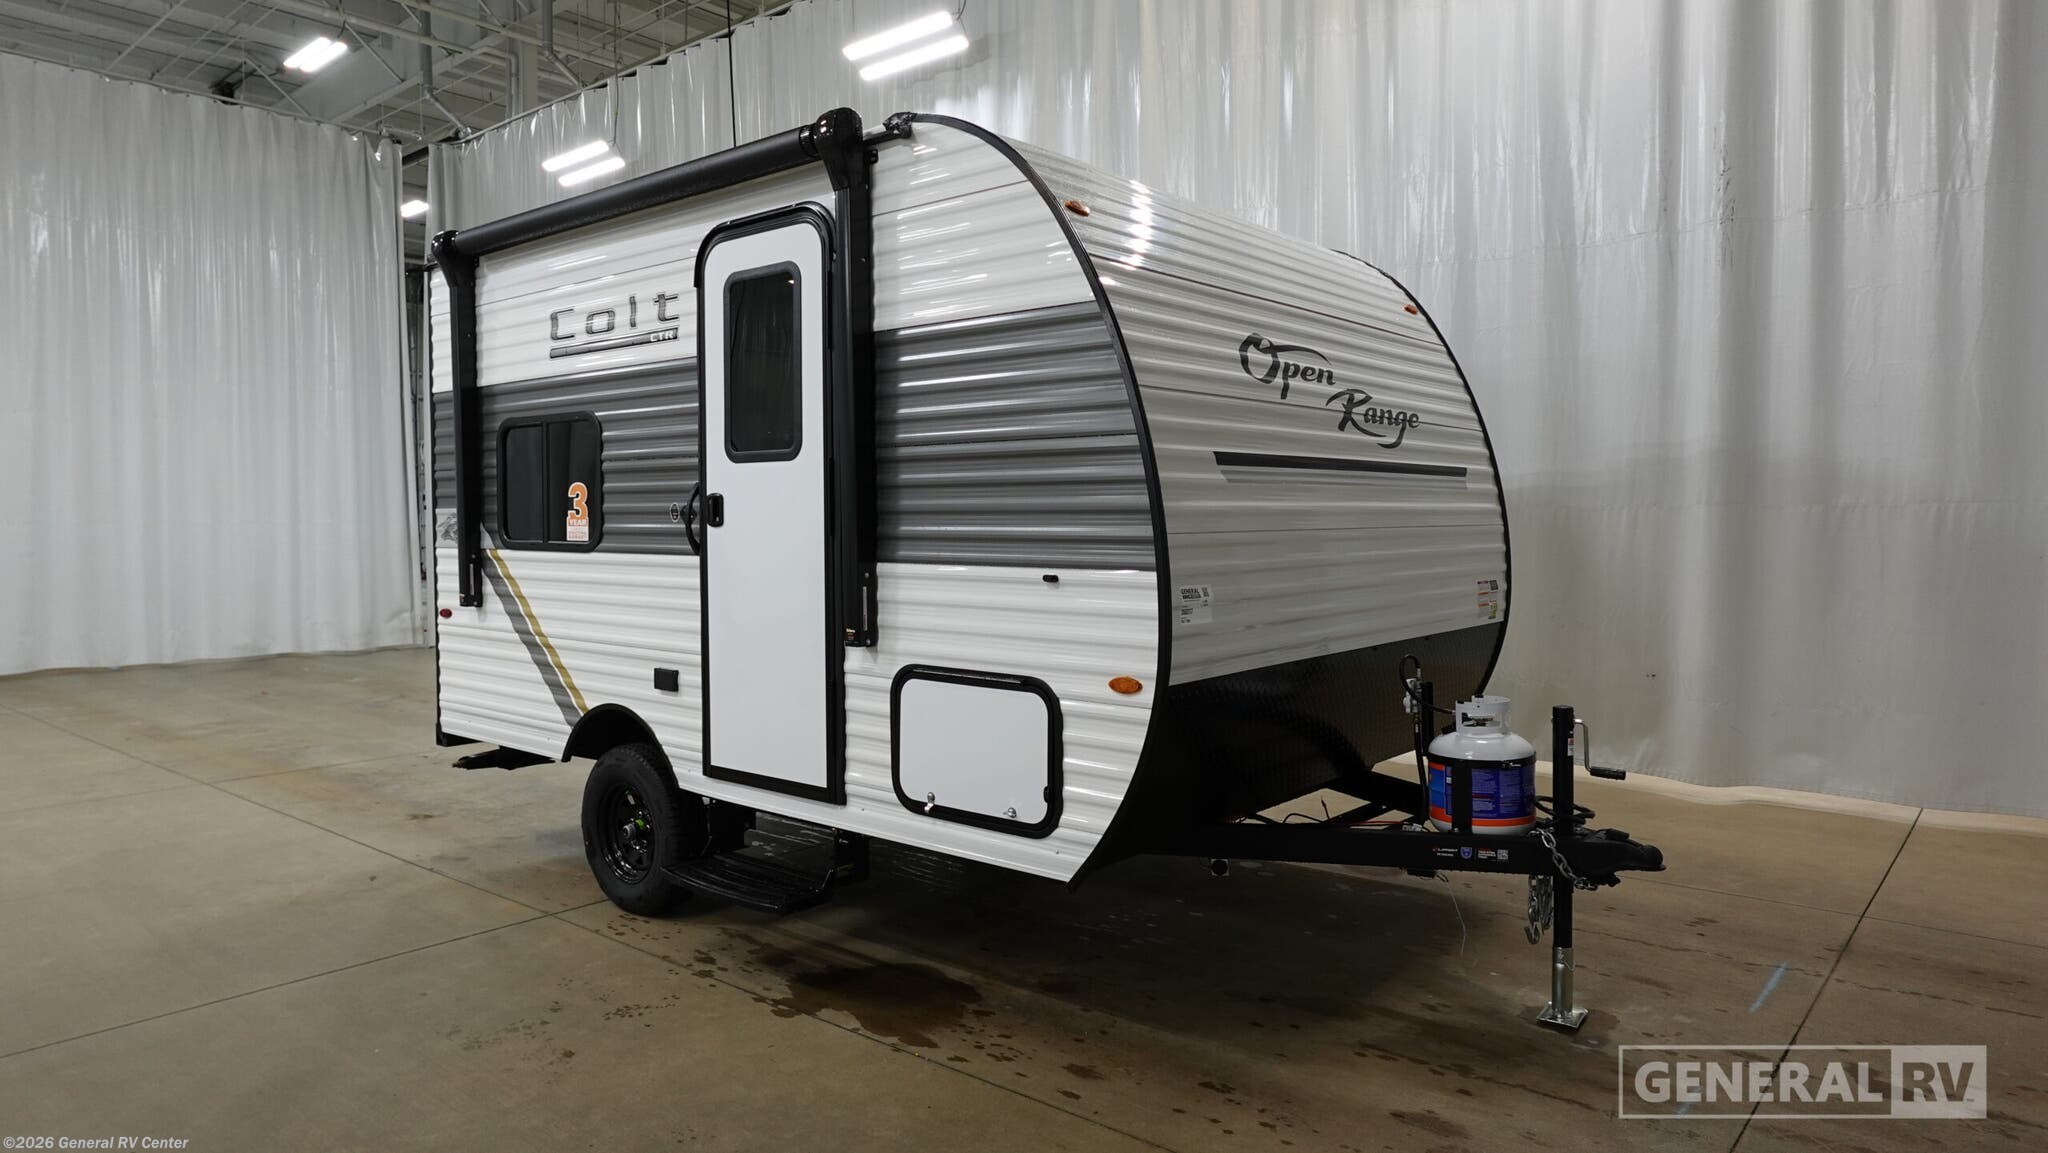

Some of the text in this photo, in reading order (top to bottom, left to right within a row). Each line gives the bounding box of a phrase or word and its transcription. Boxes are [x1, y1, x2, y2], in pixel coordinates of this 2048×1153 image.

[549, 293, 680, 341] Colt
[650, 331, 675, 343] CTR
[1238, 332, 1336, 400] Open
[1325, 388, 1420, 449] Range
[567, 482, 588, 520] 3
